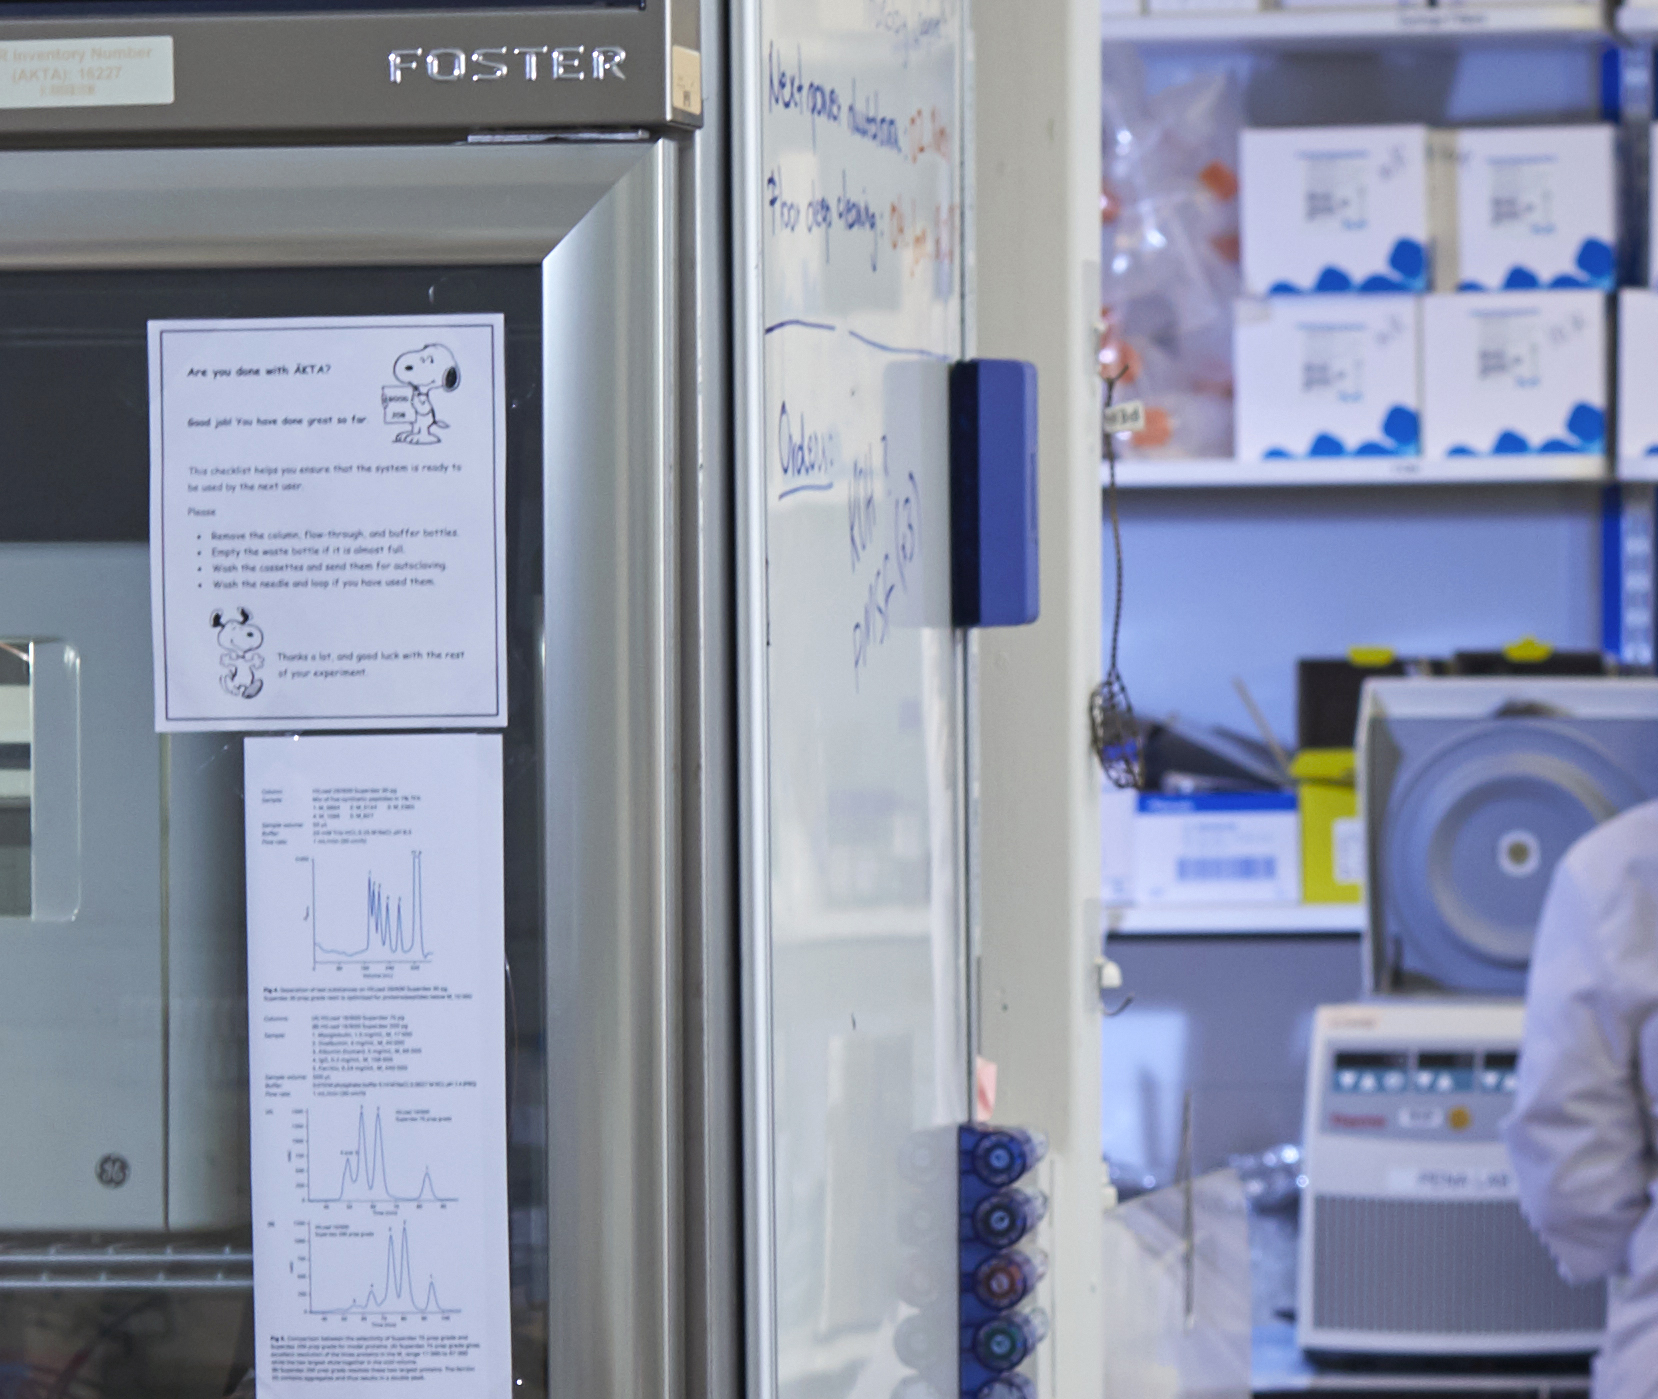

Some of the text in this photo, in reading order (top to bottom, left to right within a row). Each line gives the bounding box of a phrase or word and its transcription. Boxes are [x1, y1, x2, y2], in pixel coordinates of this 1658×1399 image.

[387, 45, 627, 84] FOSTER
[187, 368, 208, 376] Are
[212, 370, 232, 379] you
[236, 367, 260, 376] done
[265, 366, 289, 375] with
